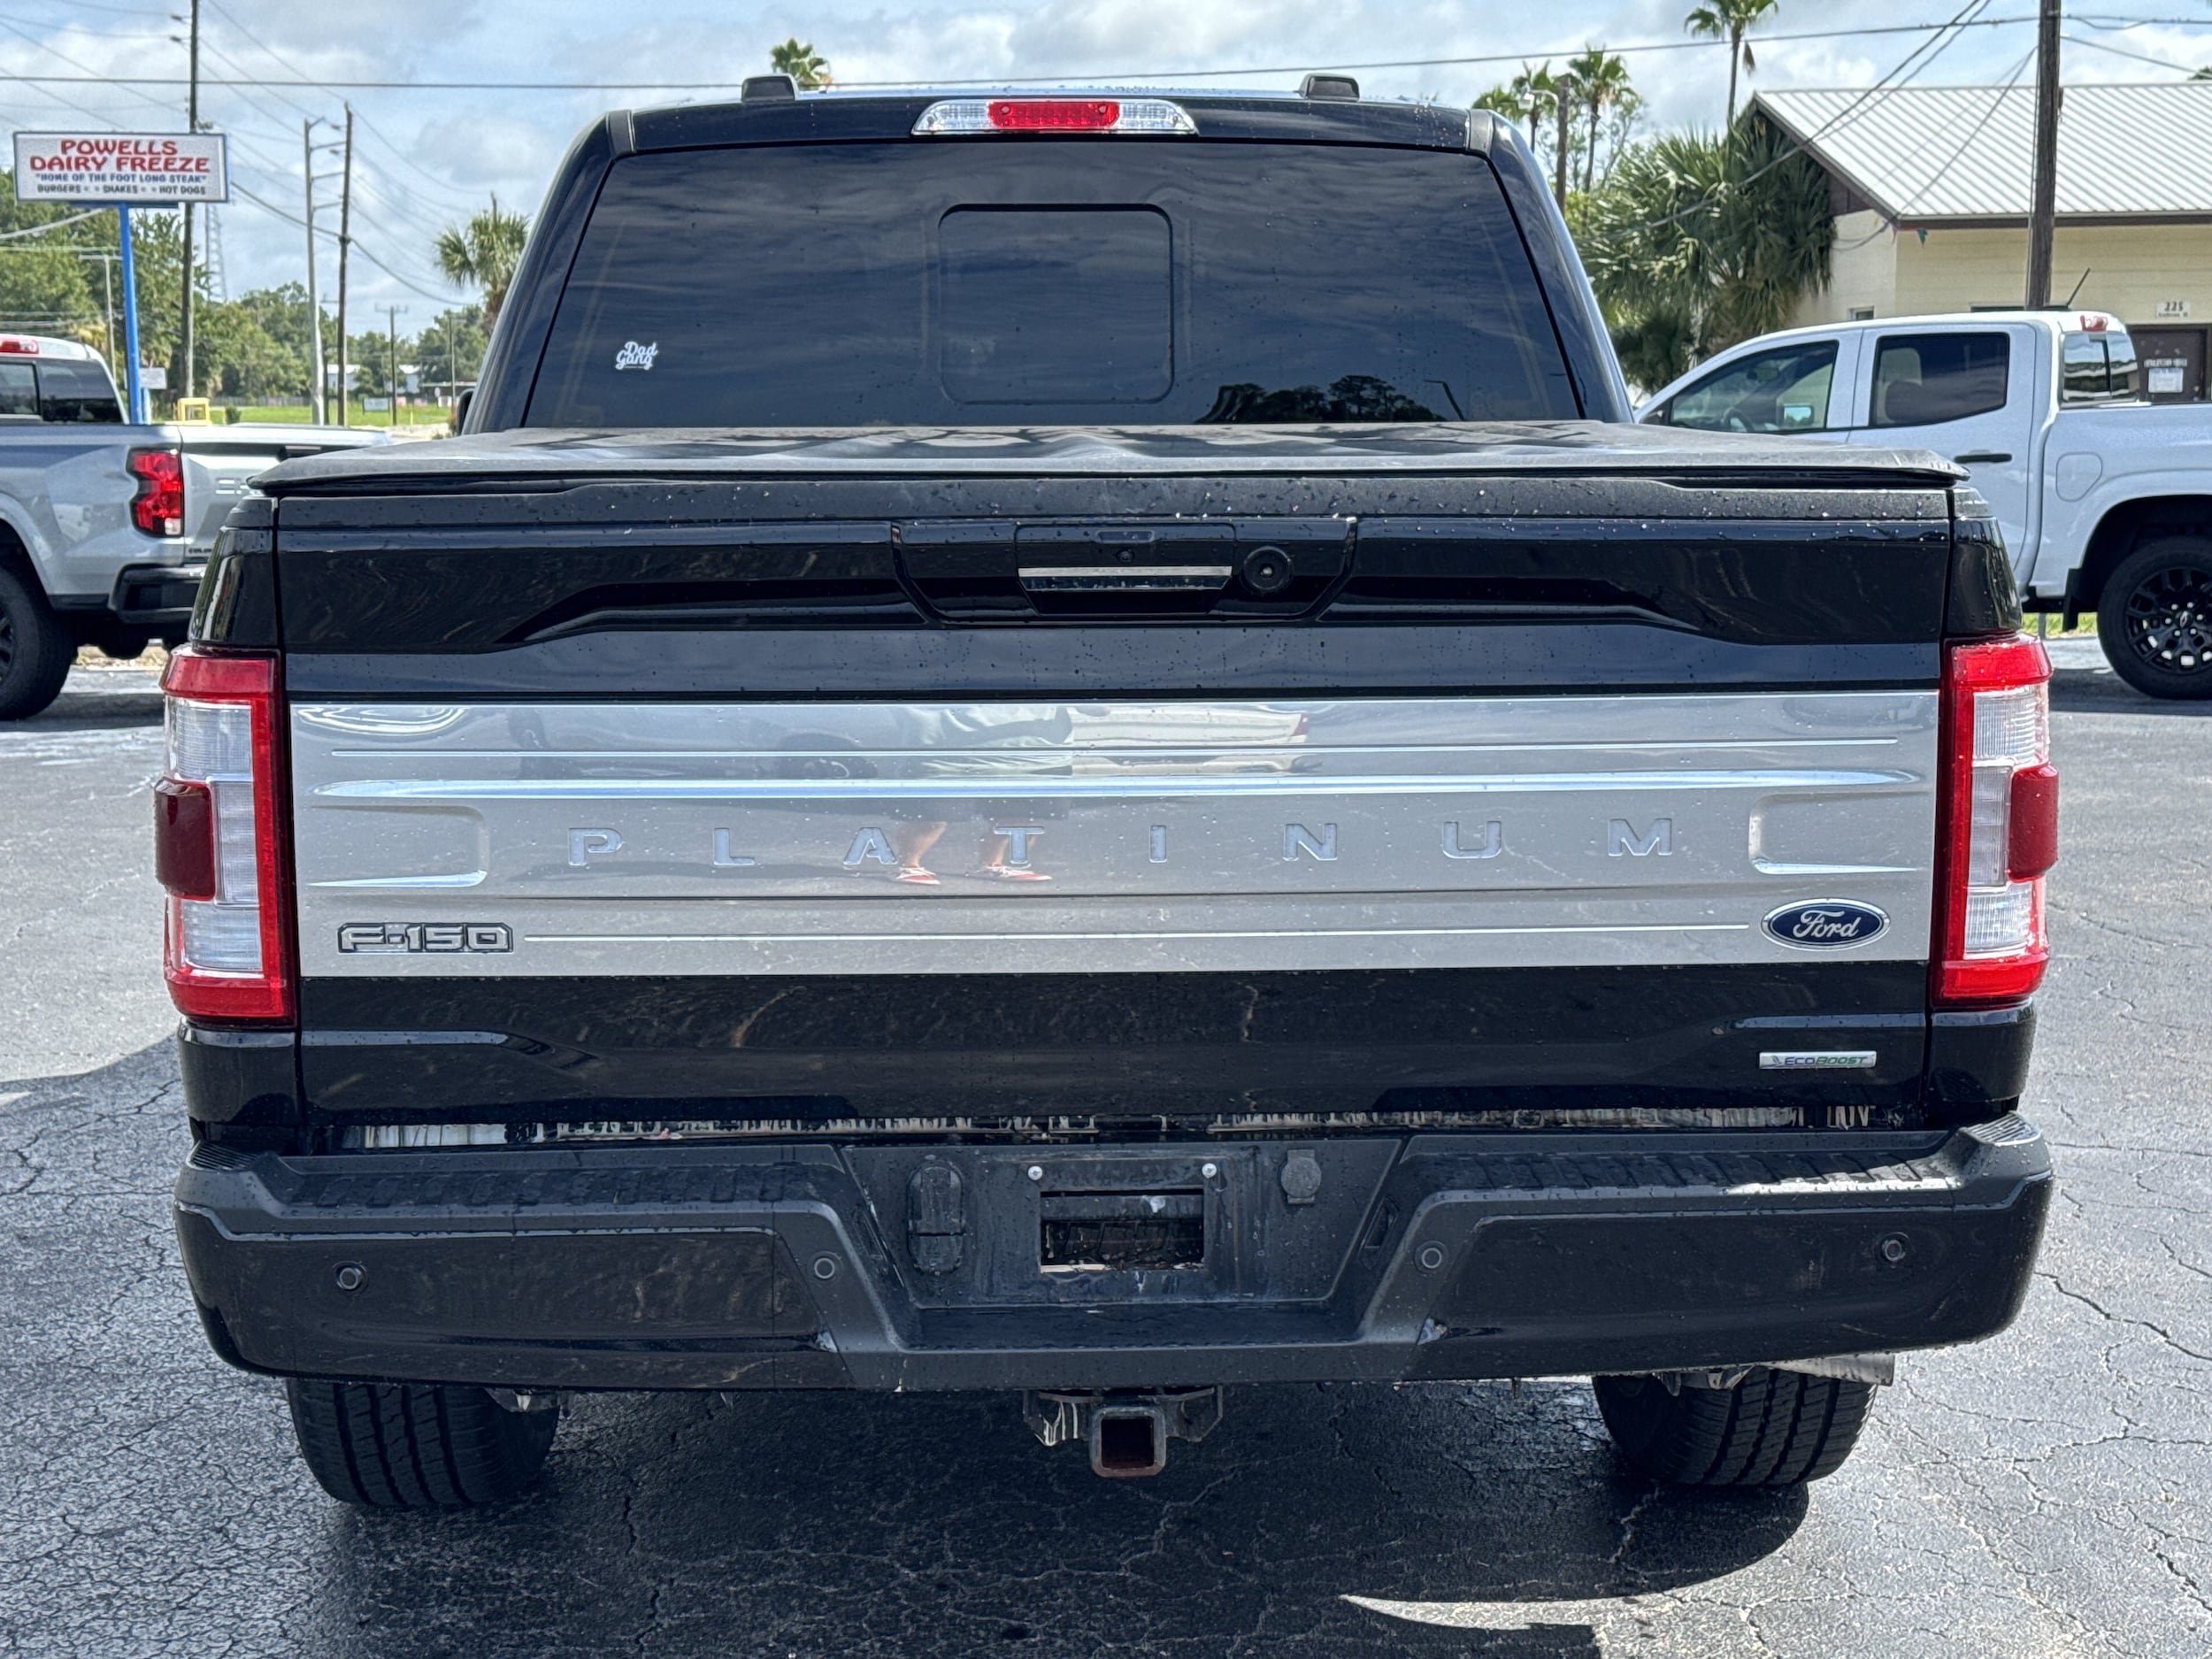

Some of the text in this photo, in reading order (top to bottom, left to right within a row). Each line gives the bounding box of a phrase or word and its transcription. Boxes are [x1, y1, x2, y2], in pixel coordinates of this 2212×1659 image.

[60, 139, 178, 156] POWELLS
[29, 156, 211, 173] DAIRY FREEZE
[89, 173, 107, 182] THE
[110, 173, 137, 182] FOOT
[140, 173, 166, 182] LONG
[37, 184, 206, 195] BURGERS SHAKES HOT DOGS
[624, 341, 659, 357] Dad
[567, 818, 1673, 866] PLATINUM
[1792, 909, 1863, 939] Ford
[337, 922, 515, 953] F-150
